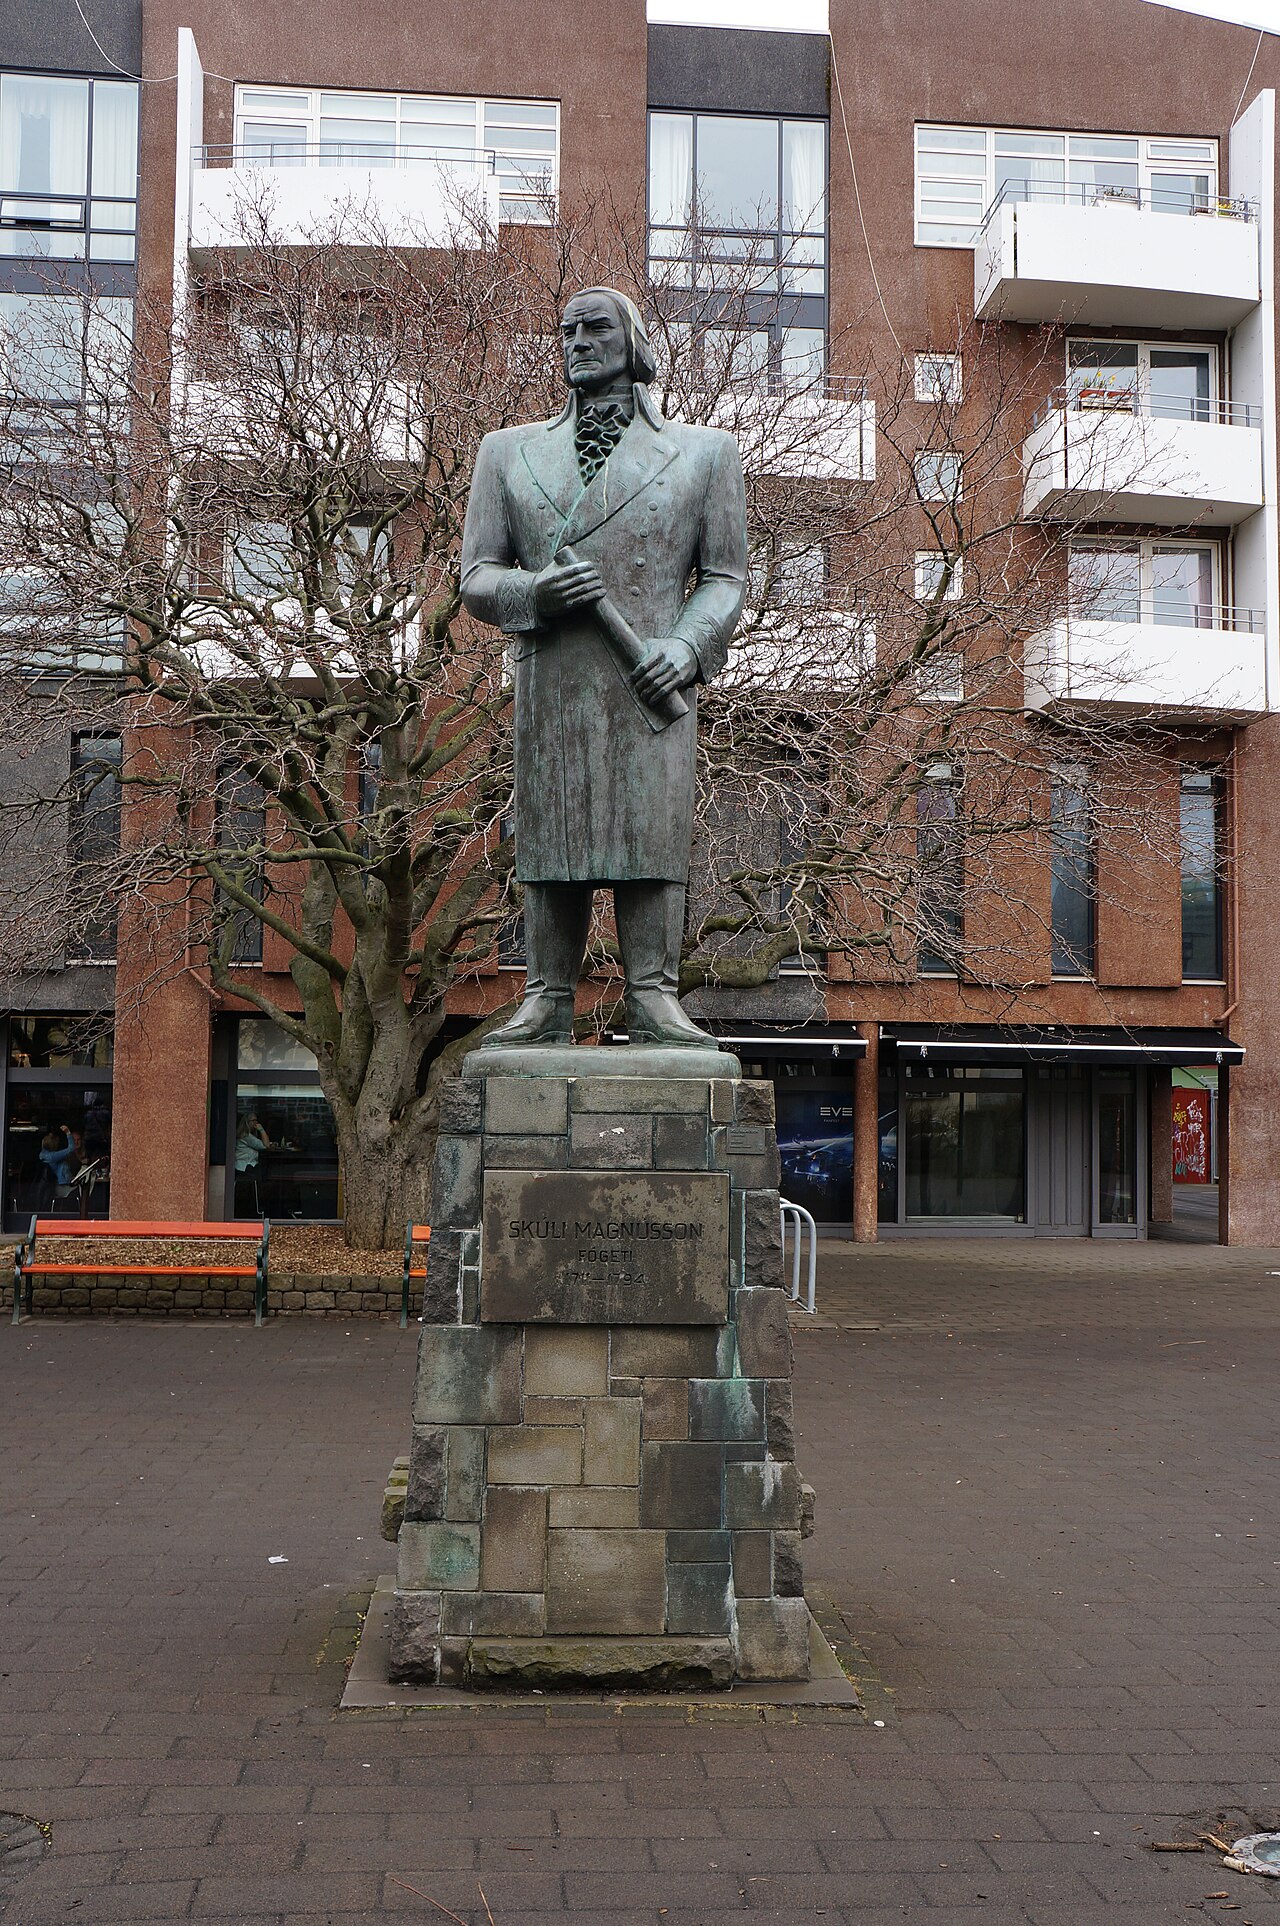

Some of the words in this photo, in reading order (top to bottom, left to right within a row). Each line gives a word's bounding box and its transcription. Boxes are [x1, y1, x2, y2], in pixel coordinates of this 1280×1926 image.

[820, 1106, 853, 1117] EVE
[508, 1216, 566, 1239] SKÚLI
[574, 1218, 703, 1241] MAGNÚSSON
[578, 1246, 633, 1263] FÓGETI
